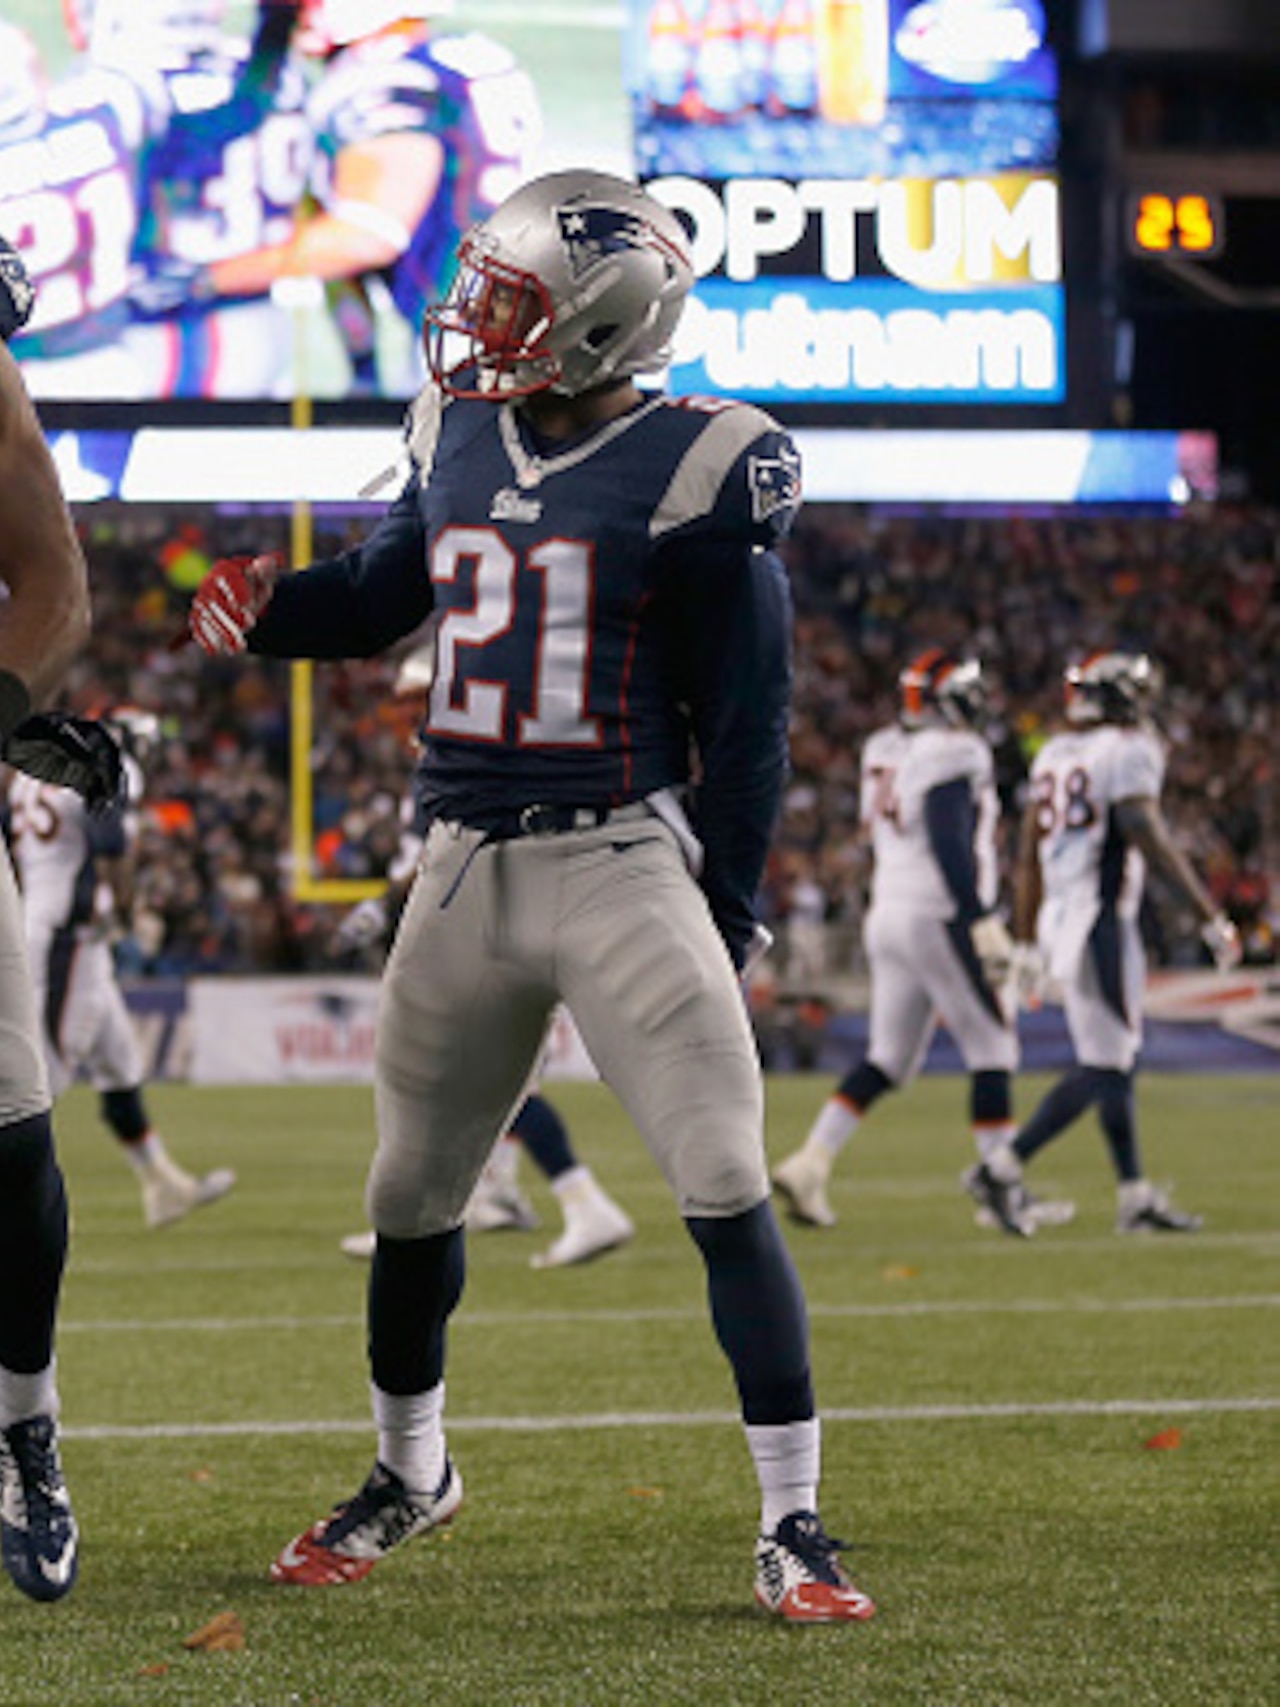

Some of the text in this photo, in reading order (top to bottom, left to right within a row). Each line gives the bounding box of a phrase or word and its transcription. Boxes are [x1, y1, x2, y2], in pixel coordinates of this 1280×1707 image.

[642, 176, 1062, 292] OPTUM
[634, 292, 1058, 390] Putnam
[426, 524, 605, 748] 21
